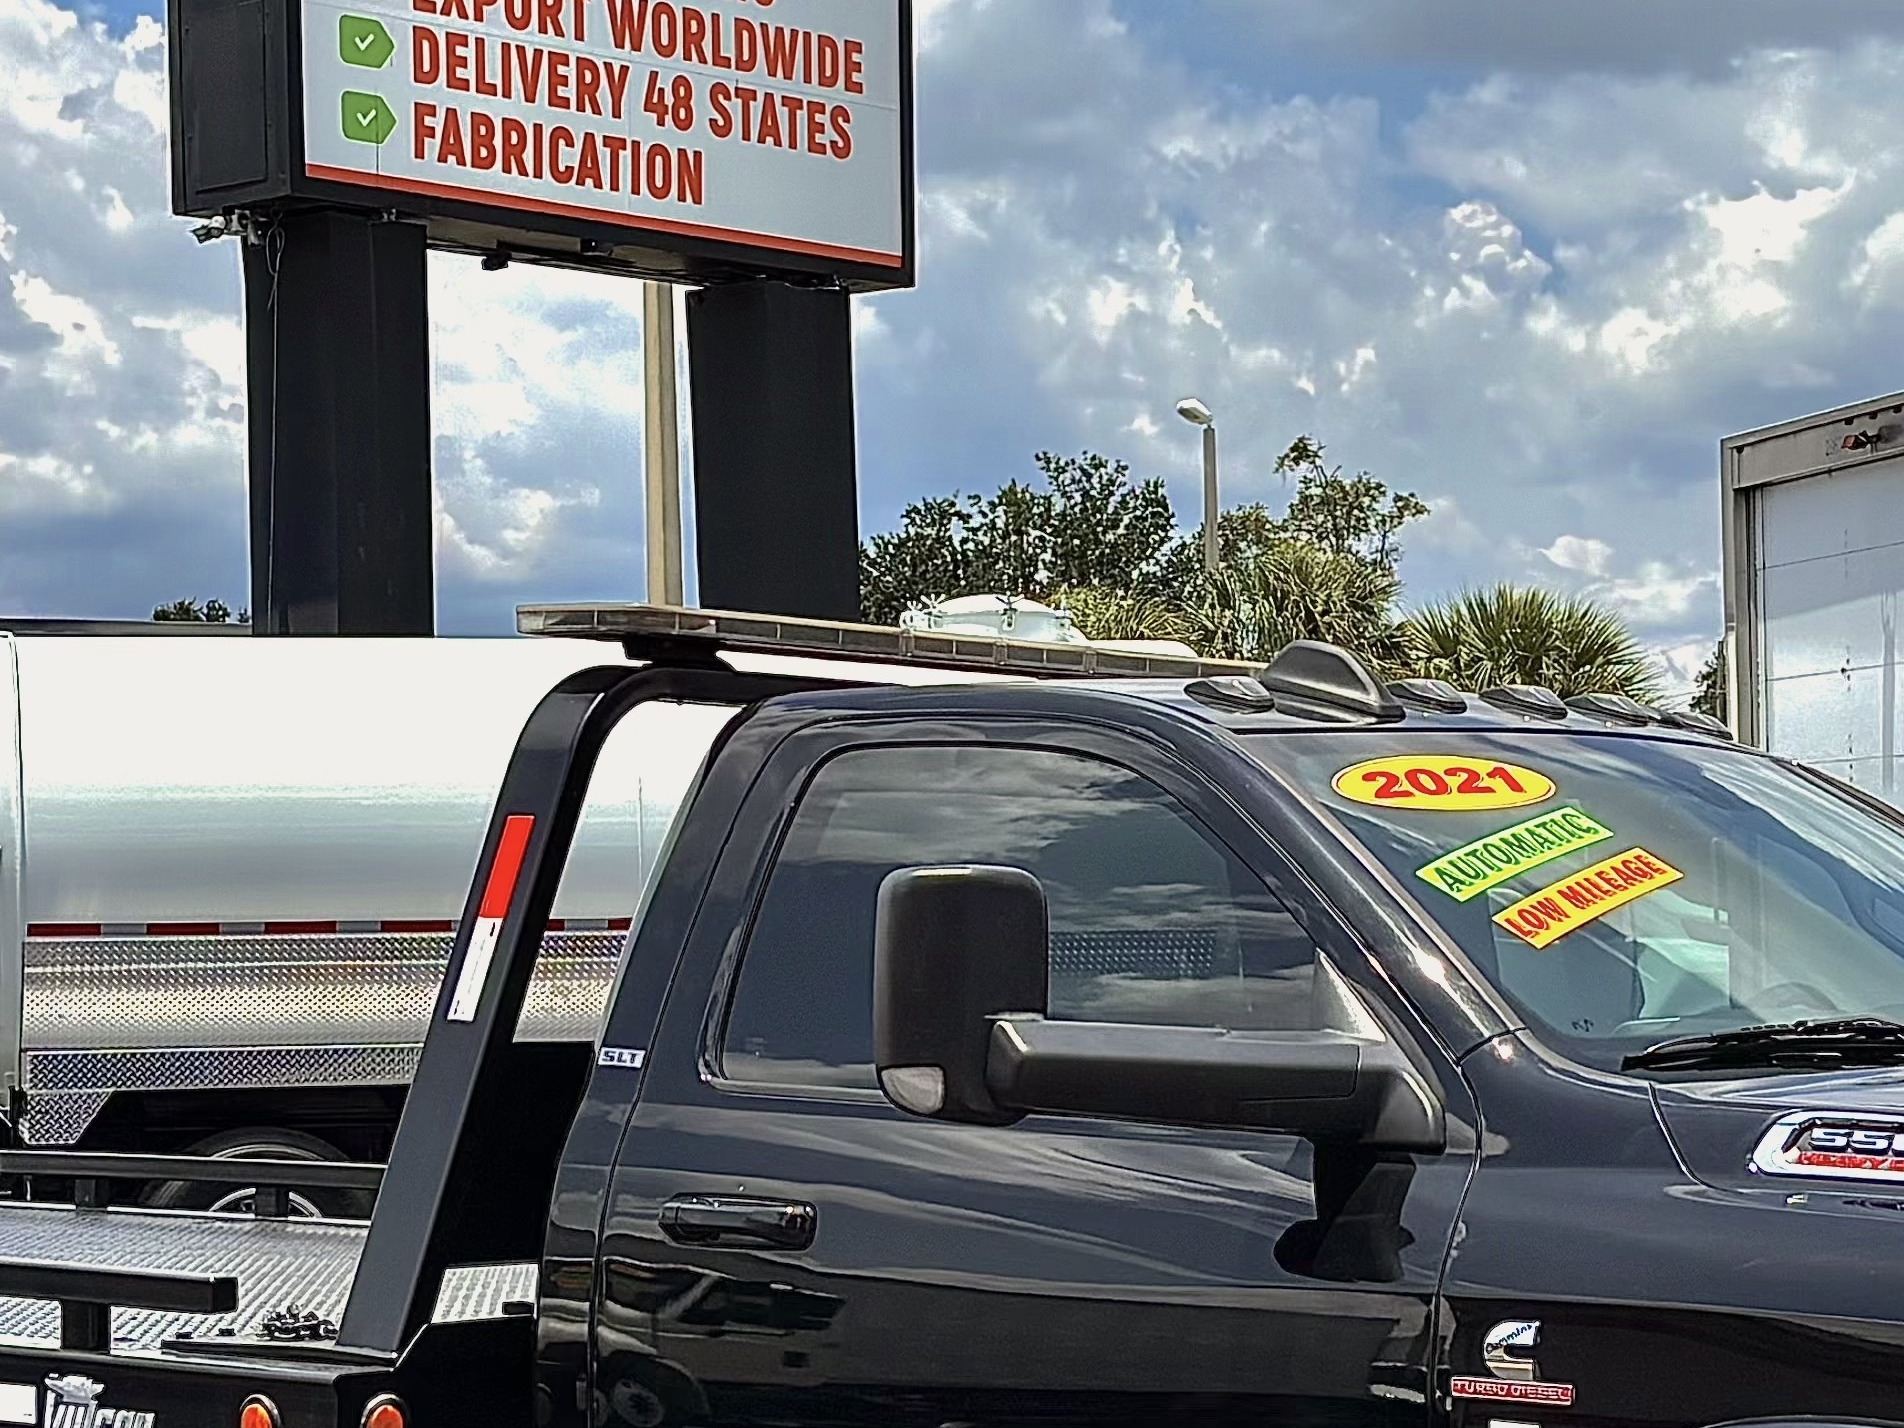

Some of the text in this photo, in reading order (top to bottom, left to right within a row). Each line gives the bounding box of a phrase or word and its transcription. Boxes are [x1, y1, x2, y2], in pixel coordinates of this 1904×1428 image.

[412, 25, 853, 160] DELIVERY 48 STATES
[413, 102, 704, 205] FABRICATION
[1361, 766, 1526, 800] 2021
[1432, 812, 1600, 893] AUTOMATIC
[1504, 853, 1669, 939] LOW MILEAGE
[601, 1050, 640, 1065] SLT
[1453, 1380, 1572, 1400] TURBO DIESEL
